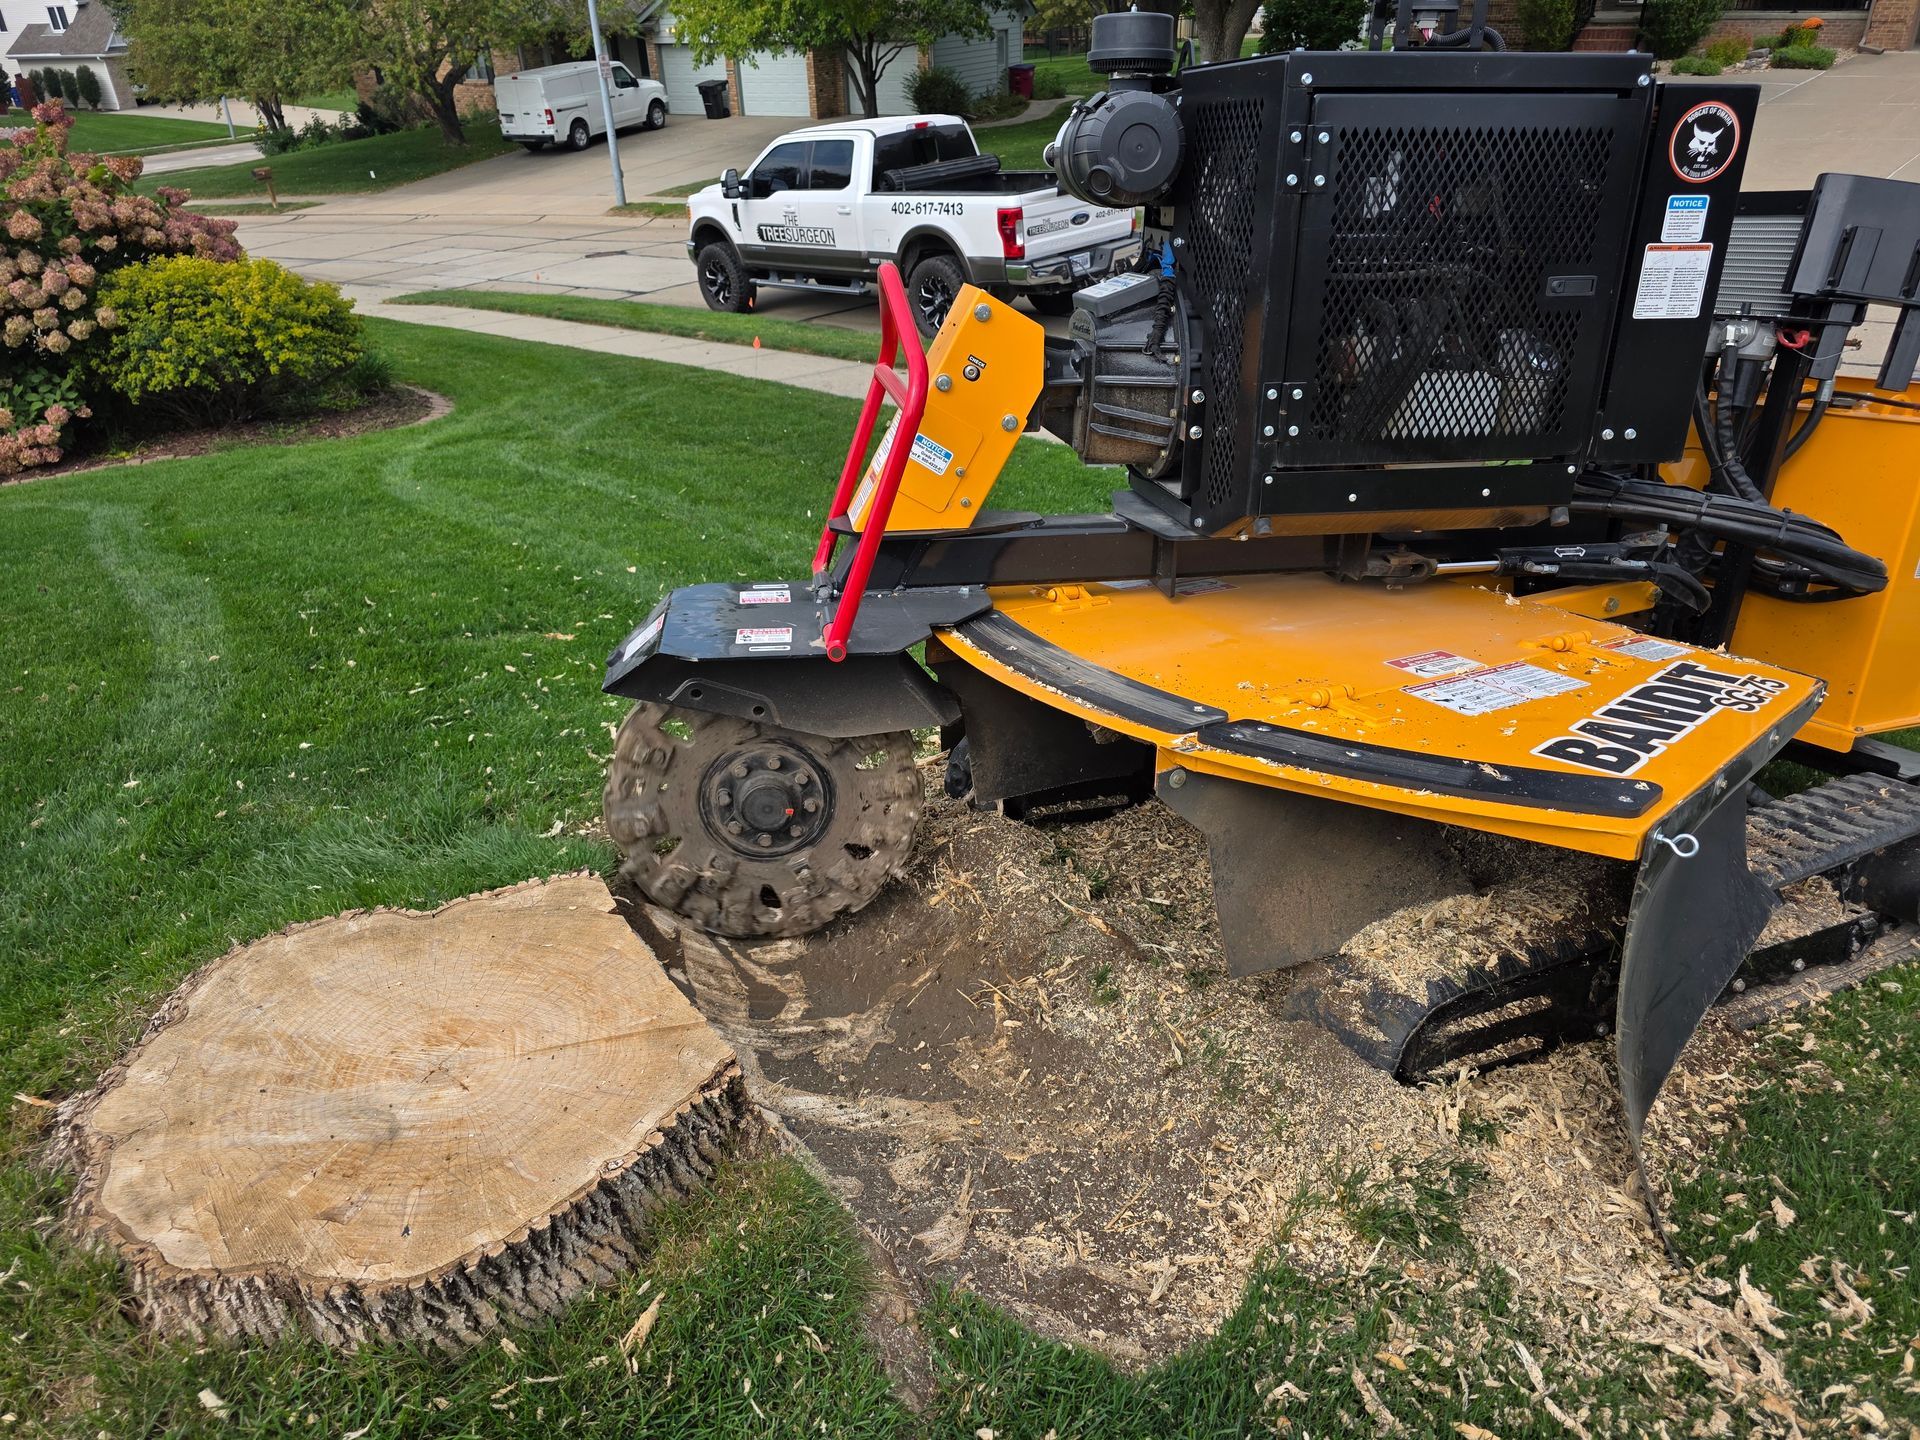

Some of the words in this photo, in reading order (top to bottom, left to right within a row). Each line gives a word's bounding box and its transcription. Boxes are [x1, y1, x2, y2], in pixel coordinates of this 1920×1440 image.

[1687, 107, 1709, 123] BOBCAT
[1717, 108, 1733, 127] OMAHA
[891, 202, 963, 216] 402-617-7413
[783, 214, 798, 226] THE
[920, 450, 932, 460] Grade
[921, 438, 946, 456] NOTICE
[1714, 674, 1788, 712] SG-75
[1534, 661, 1748, 775] BANDIT
